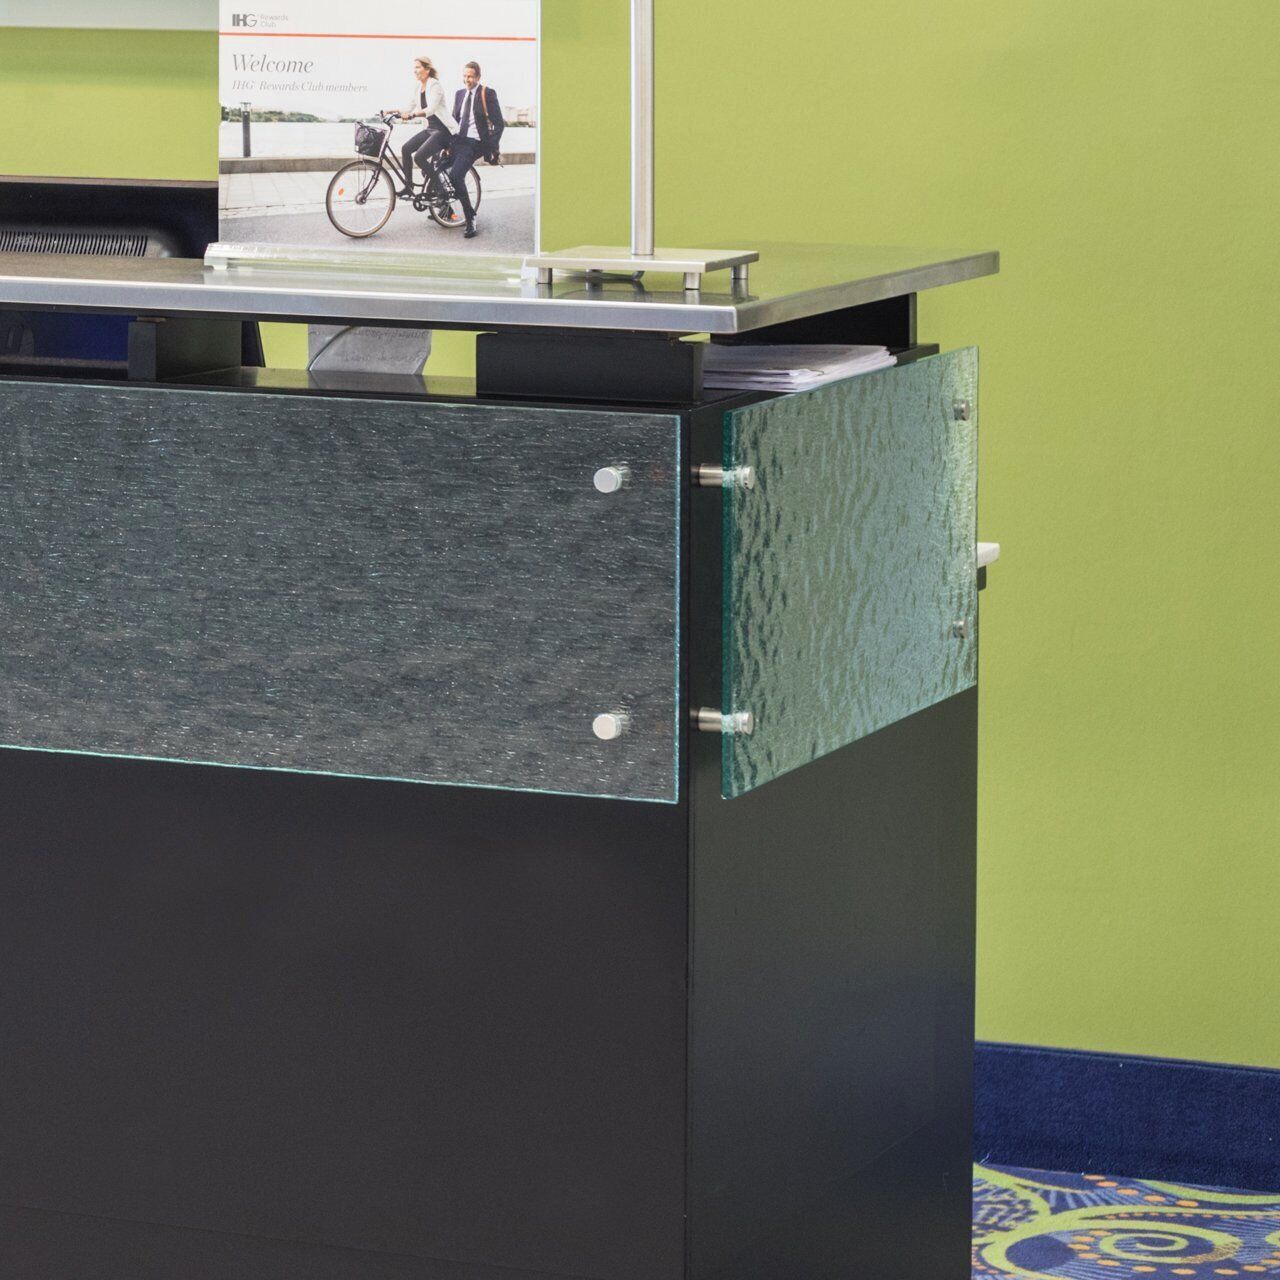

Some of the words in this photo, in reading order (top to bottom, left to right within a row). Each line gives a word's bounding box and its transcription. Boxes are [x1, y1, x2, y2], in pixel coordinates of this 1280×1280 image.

[231, 13, 258, 28] IHG
[260, 14, 289, 22] Rewards
[260, 20, 277, 28] Club
[232, 53, 315, 74] Welcome
[259, 80, 300, 92] Rewards
[301, 81, 324, 93] Club
